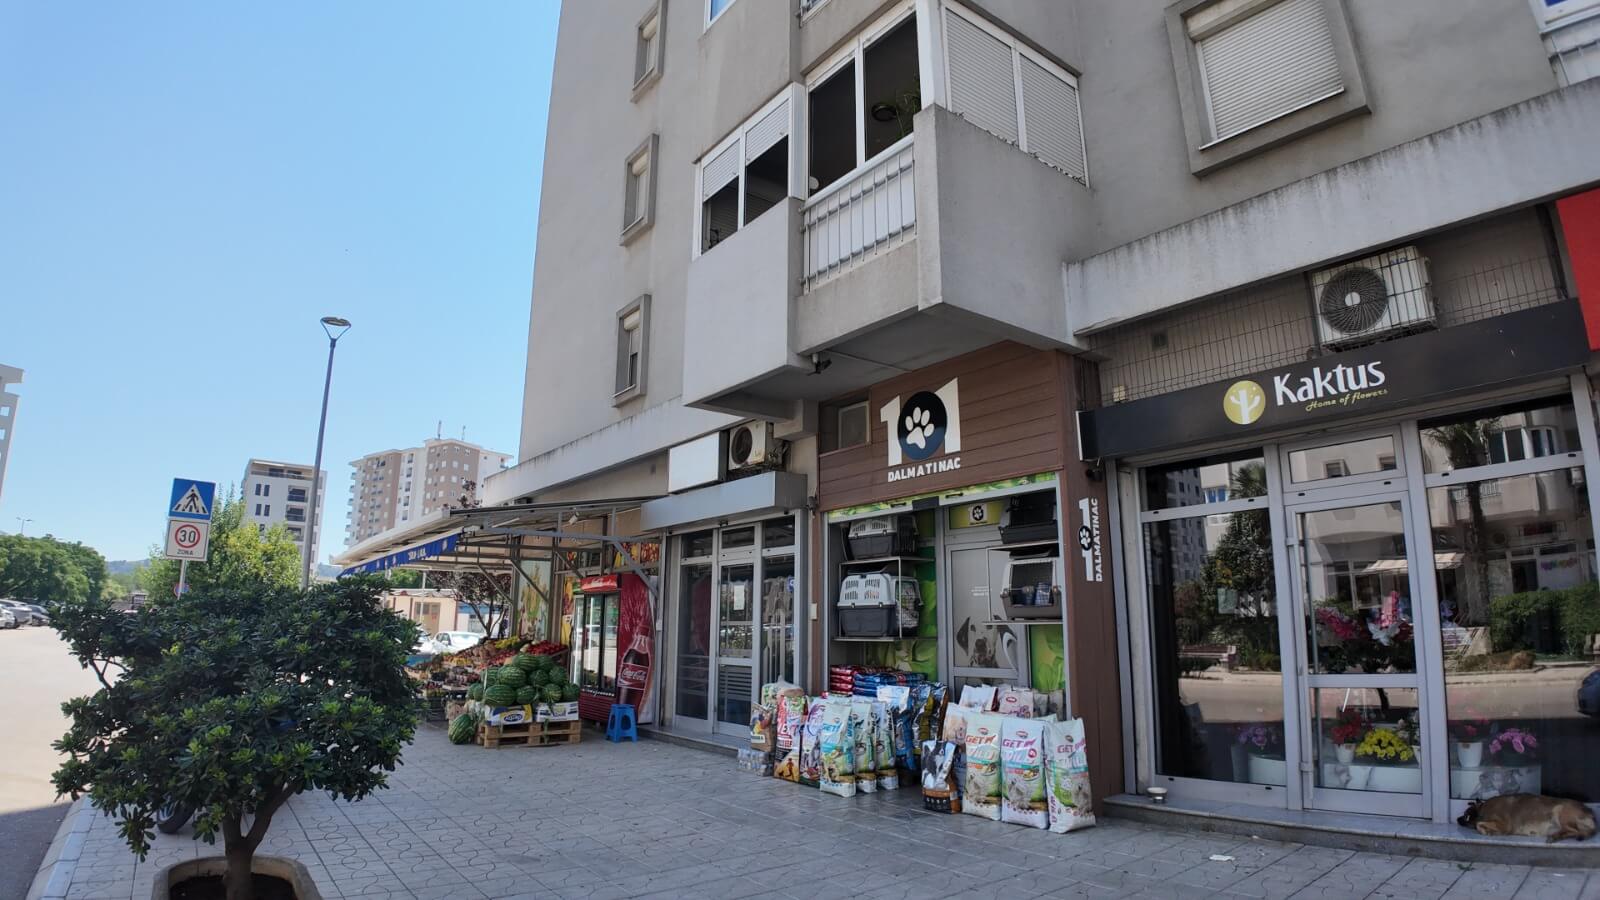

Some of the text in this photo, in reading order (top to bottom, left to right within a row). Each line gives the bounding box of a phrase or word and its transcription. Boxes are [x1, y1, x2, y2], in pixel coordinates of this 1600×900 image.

[1273, 360, 1386, 406] Kaktus
[1305, 388, 1389, 412] Home of flowers
[887, 457, 961, 482] DALMATINAC
[179, 530, 197, 543] 30
[1091, 498, 1103, 582] DALMATINAC
[1002, 738, 1025, 748] GET
[1056, 744, 1073, 754] GET
